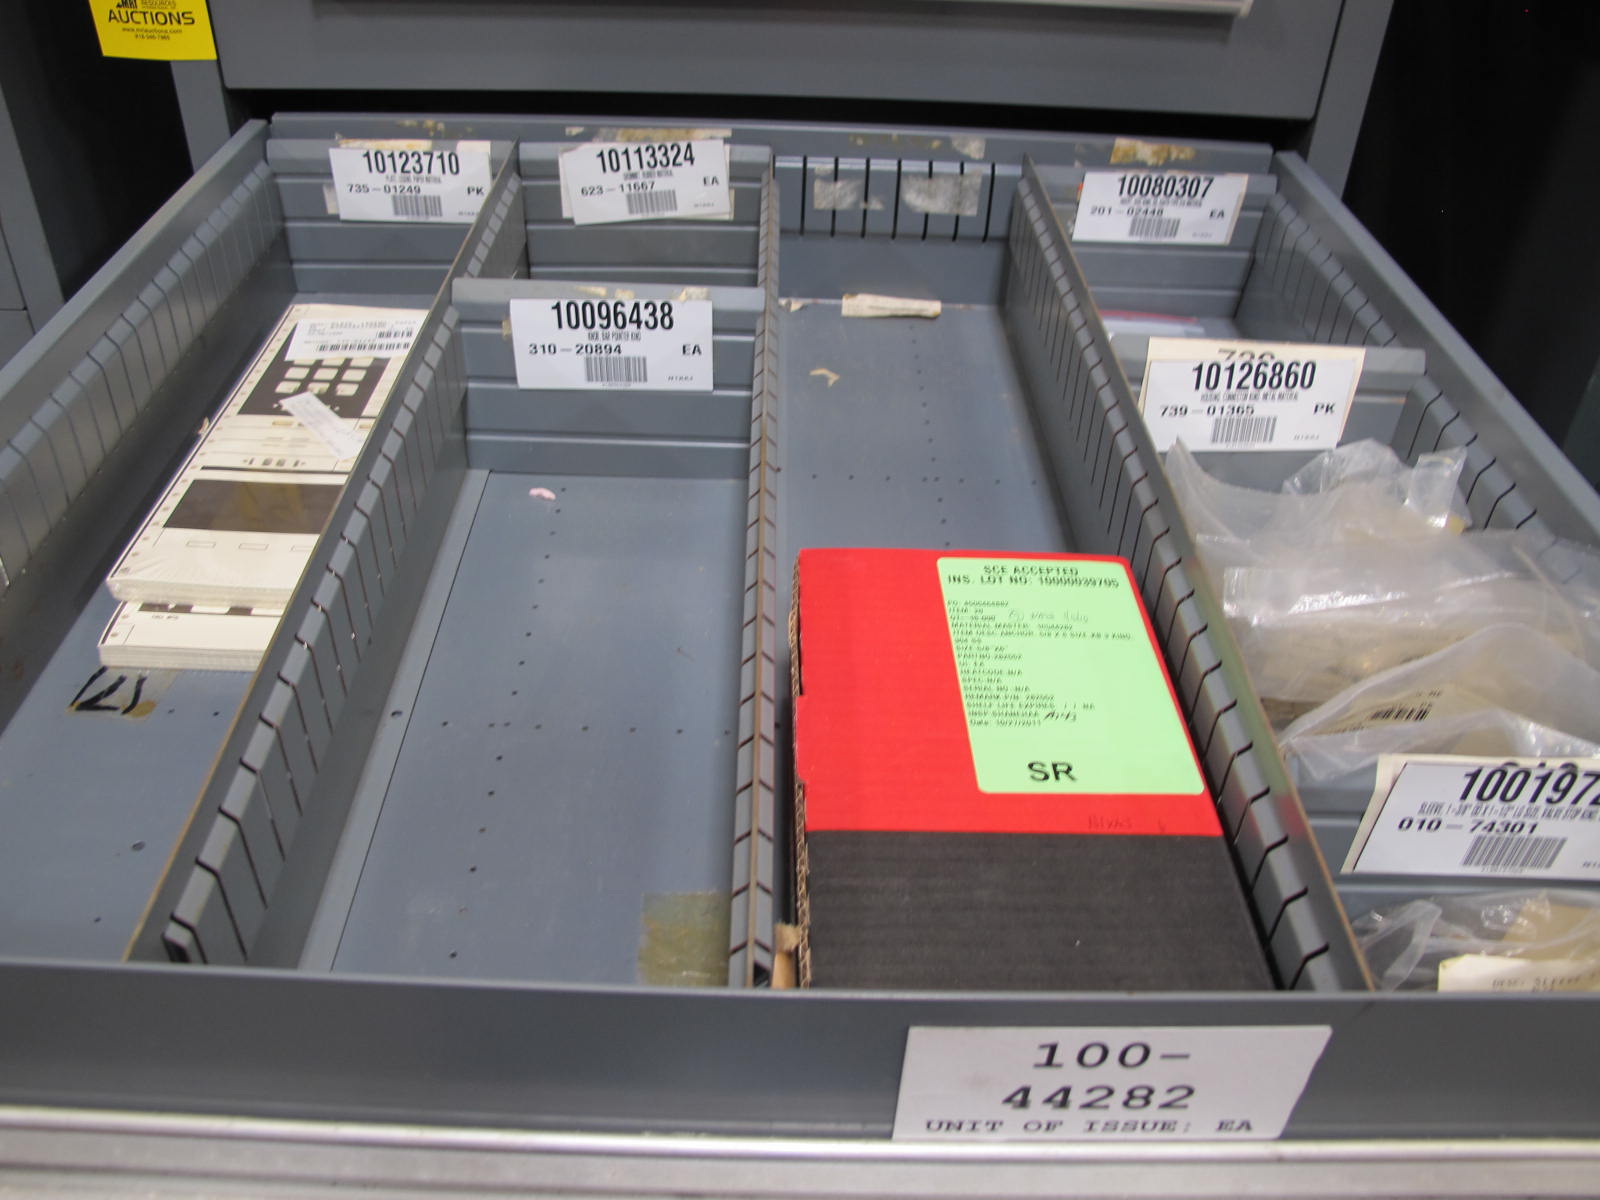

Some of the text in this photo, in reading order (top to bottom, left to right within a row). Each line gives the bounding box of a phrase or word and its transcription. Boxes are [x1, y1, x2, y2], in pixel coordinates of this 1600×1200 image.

[108, 9, 195, 26] AUCTIONS
[362, 150, 460, 175] 10123710
[596, 142, 695, 175] 10113324
[467, 185, 484, 196] PK
[580, 175, 720, 197] 623-11667 EA
[1118, 174, 1215, 199] 10080307
[1209, 208, 1225, 219] EA
[551, 300, 674, 330] 10096438
[529, 343, 702, 356] 310-20894 EA
[1192, 360, 1317, 391] 10126860
[1160, 403, 1336, 418] 739-01365 PK
[983, 564, 1079, 576] SCE ACCEPTED
[980, 575, 1004, 585] LOT
[1028, 761, 1077, 782] SR
[1397, 817, 1539, 834] 010-74301
[1032, 1042, 1191, 1070] 100-
[1002, 1085, 1197, 1111] 44282
[924, 1119, 1254, 1134] UNIT OF ISSUE: EA
